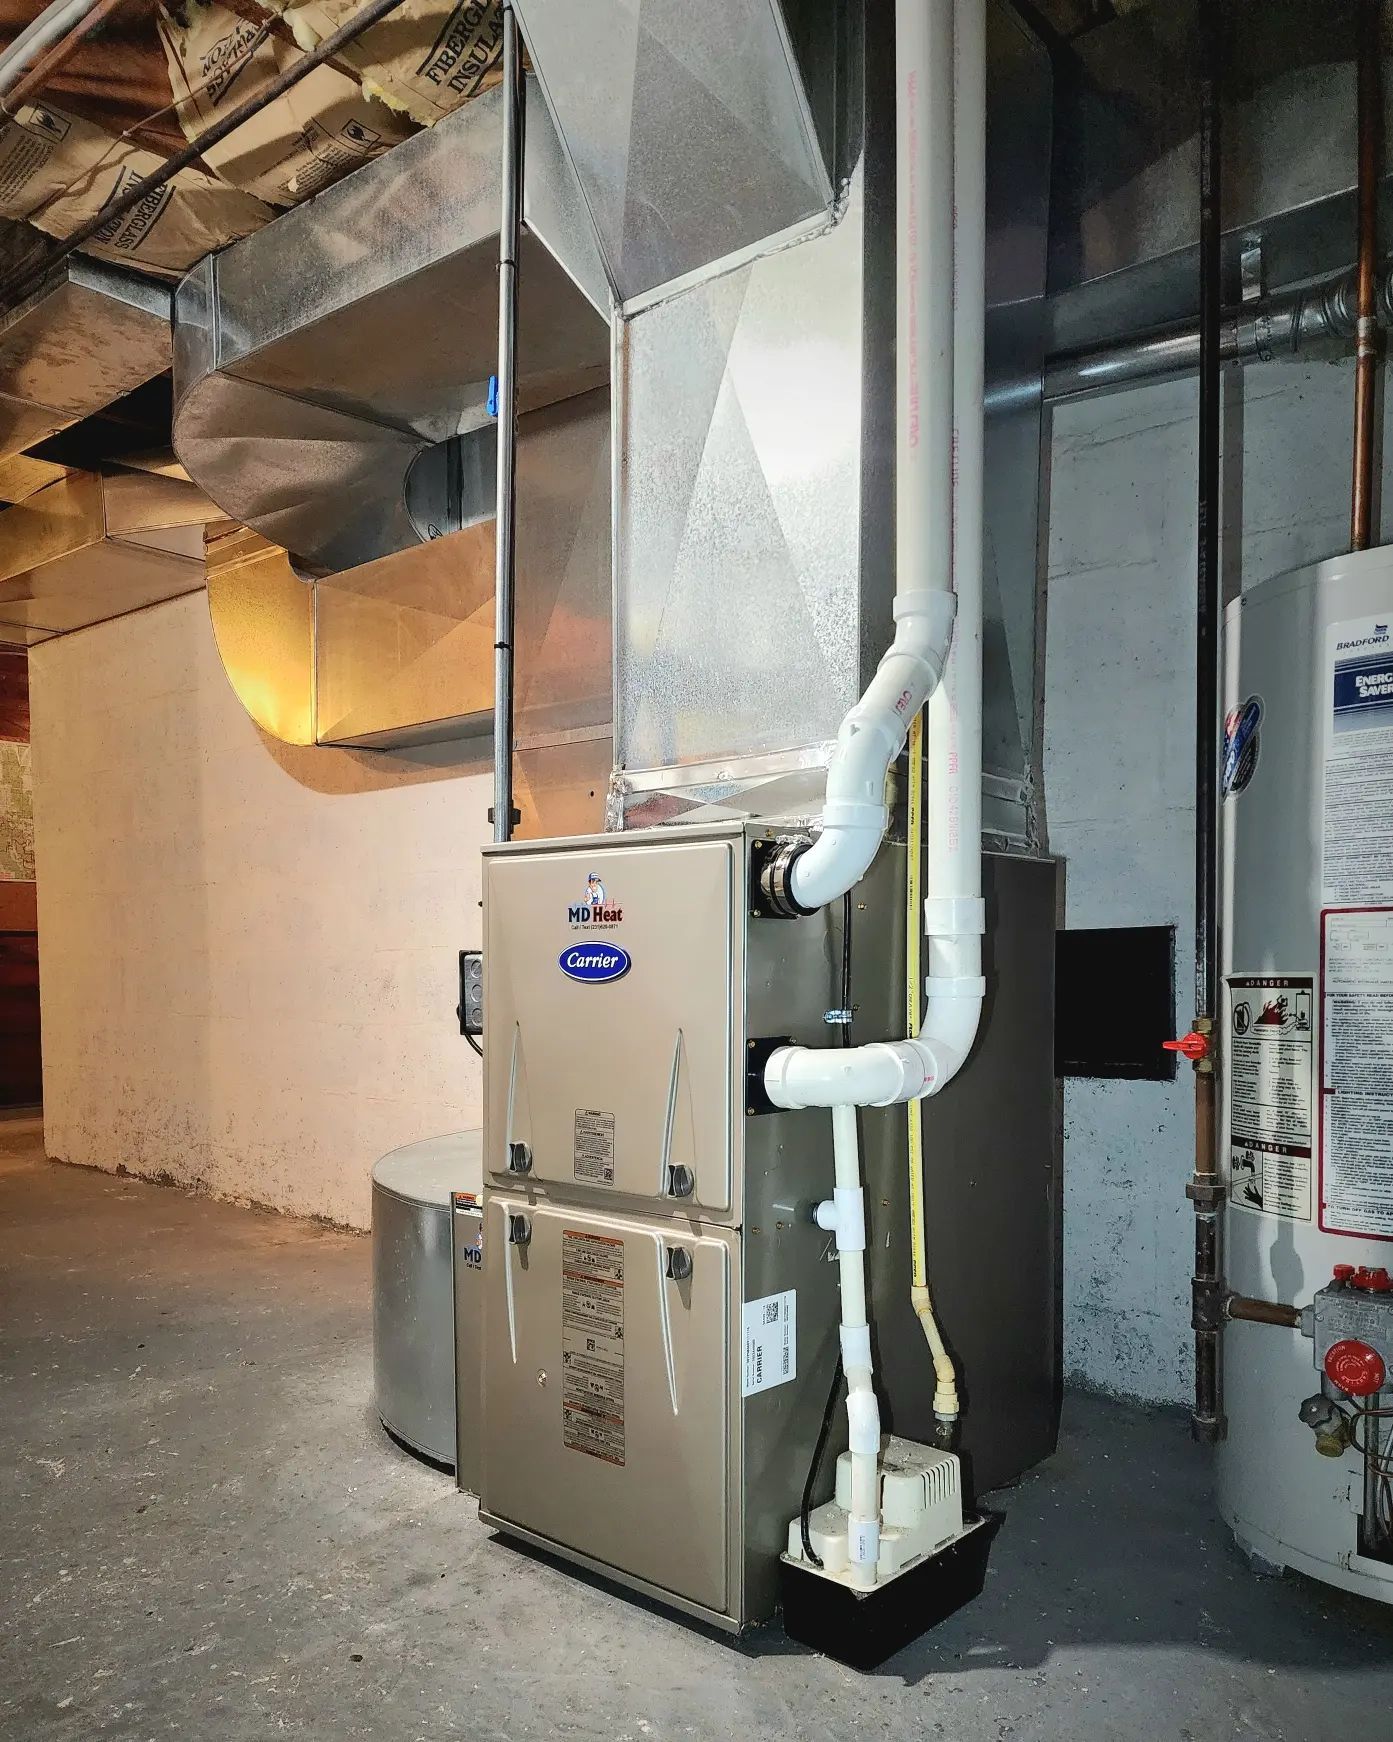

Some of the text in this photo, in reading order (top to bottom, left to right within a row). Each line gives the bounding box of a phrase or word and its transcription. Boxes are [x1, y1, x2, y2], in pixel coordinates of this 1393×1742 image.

[1336, 635, 1390, 650] BRADFORD
[568, 906, 623, 923] MD Heat
[567, 951, 618, 968] Carrier
[1250, 979, 1289, 987] DANGER
[1249, 1142, 1287, 1153] DANGER
[464, 1247, 481, 1263] MD
